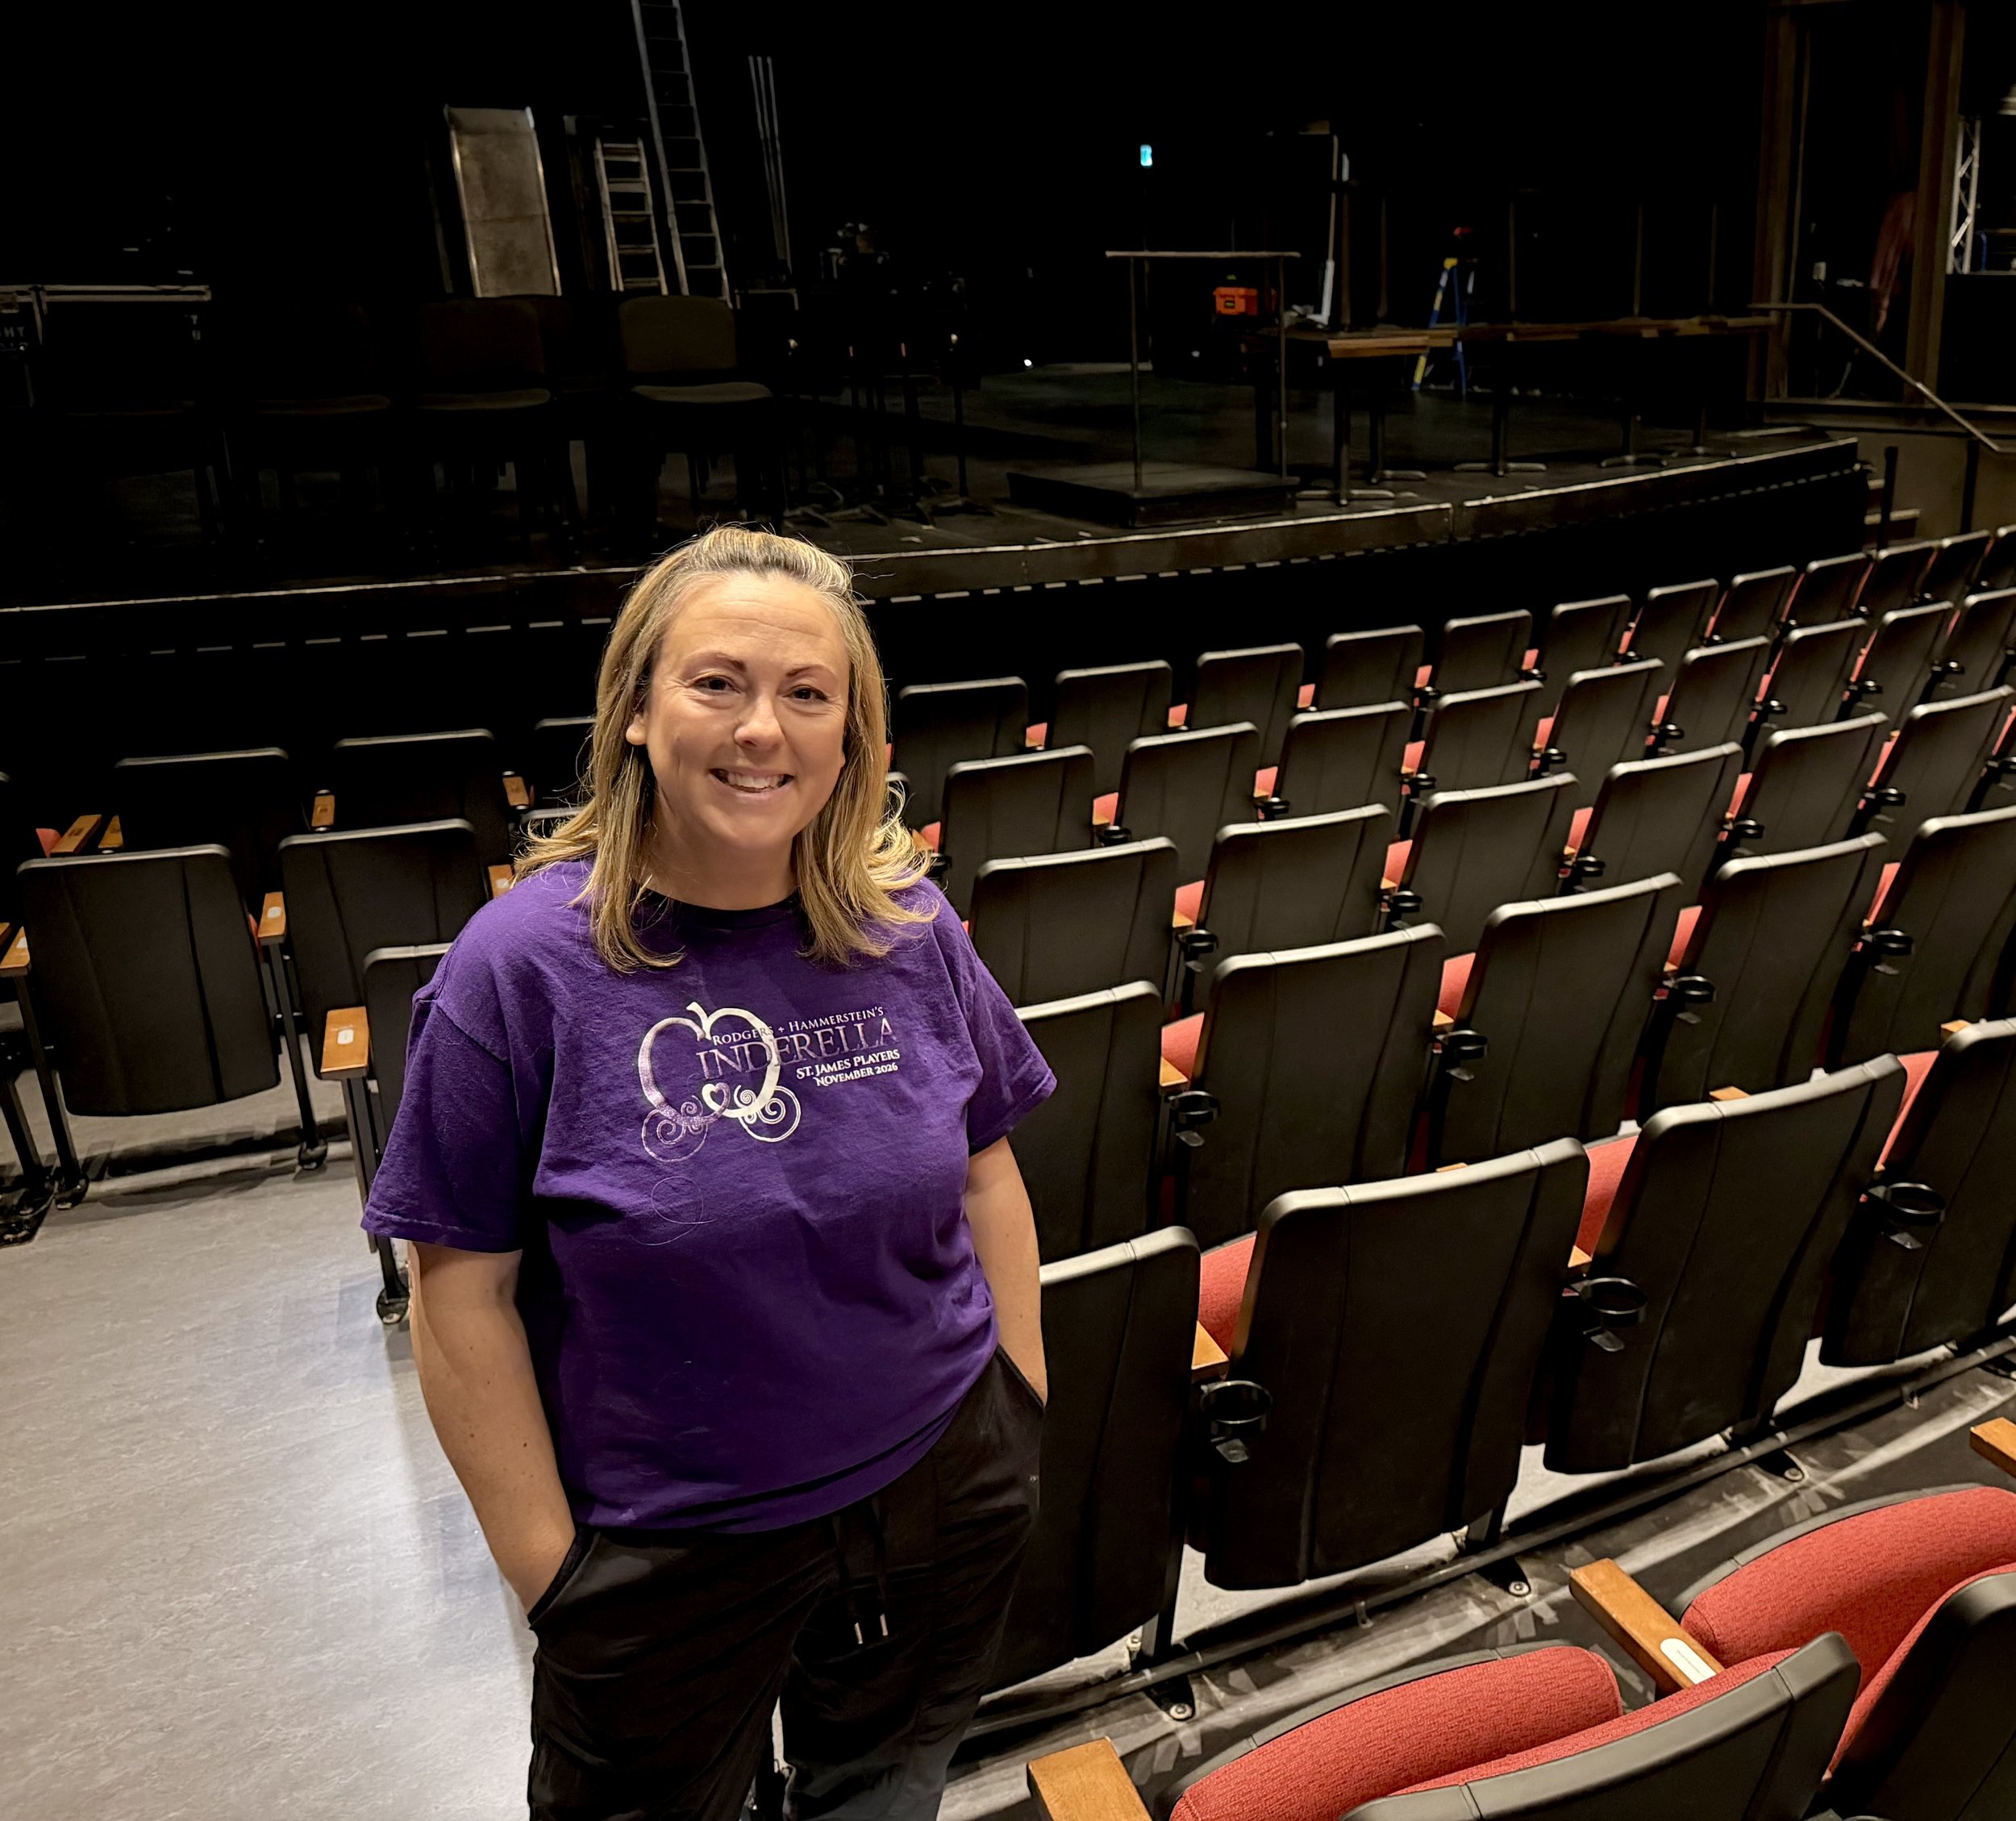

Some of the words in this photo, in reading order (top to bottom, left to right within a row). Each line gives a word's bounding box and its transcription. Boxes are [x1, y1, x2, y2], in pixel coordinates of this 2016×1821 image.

[712, 1026, 774, 1046] RODGERS
[789, 1006, 884, 1032] HAMMERSTEIN'S
[796, 1066, 814, 1080] ST.
[814, 1058, 852, 1076] JAMES
[852, 1049, 901, 1067] PLAYERS
[812, 1068, 875, 1087] NOVEMBER
[874, 1061, 898, 1075] 2026
